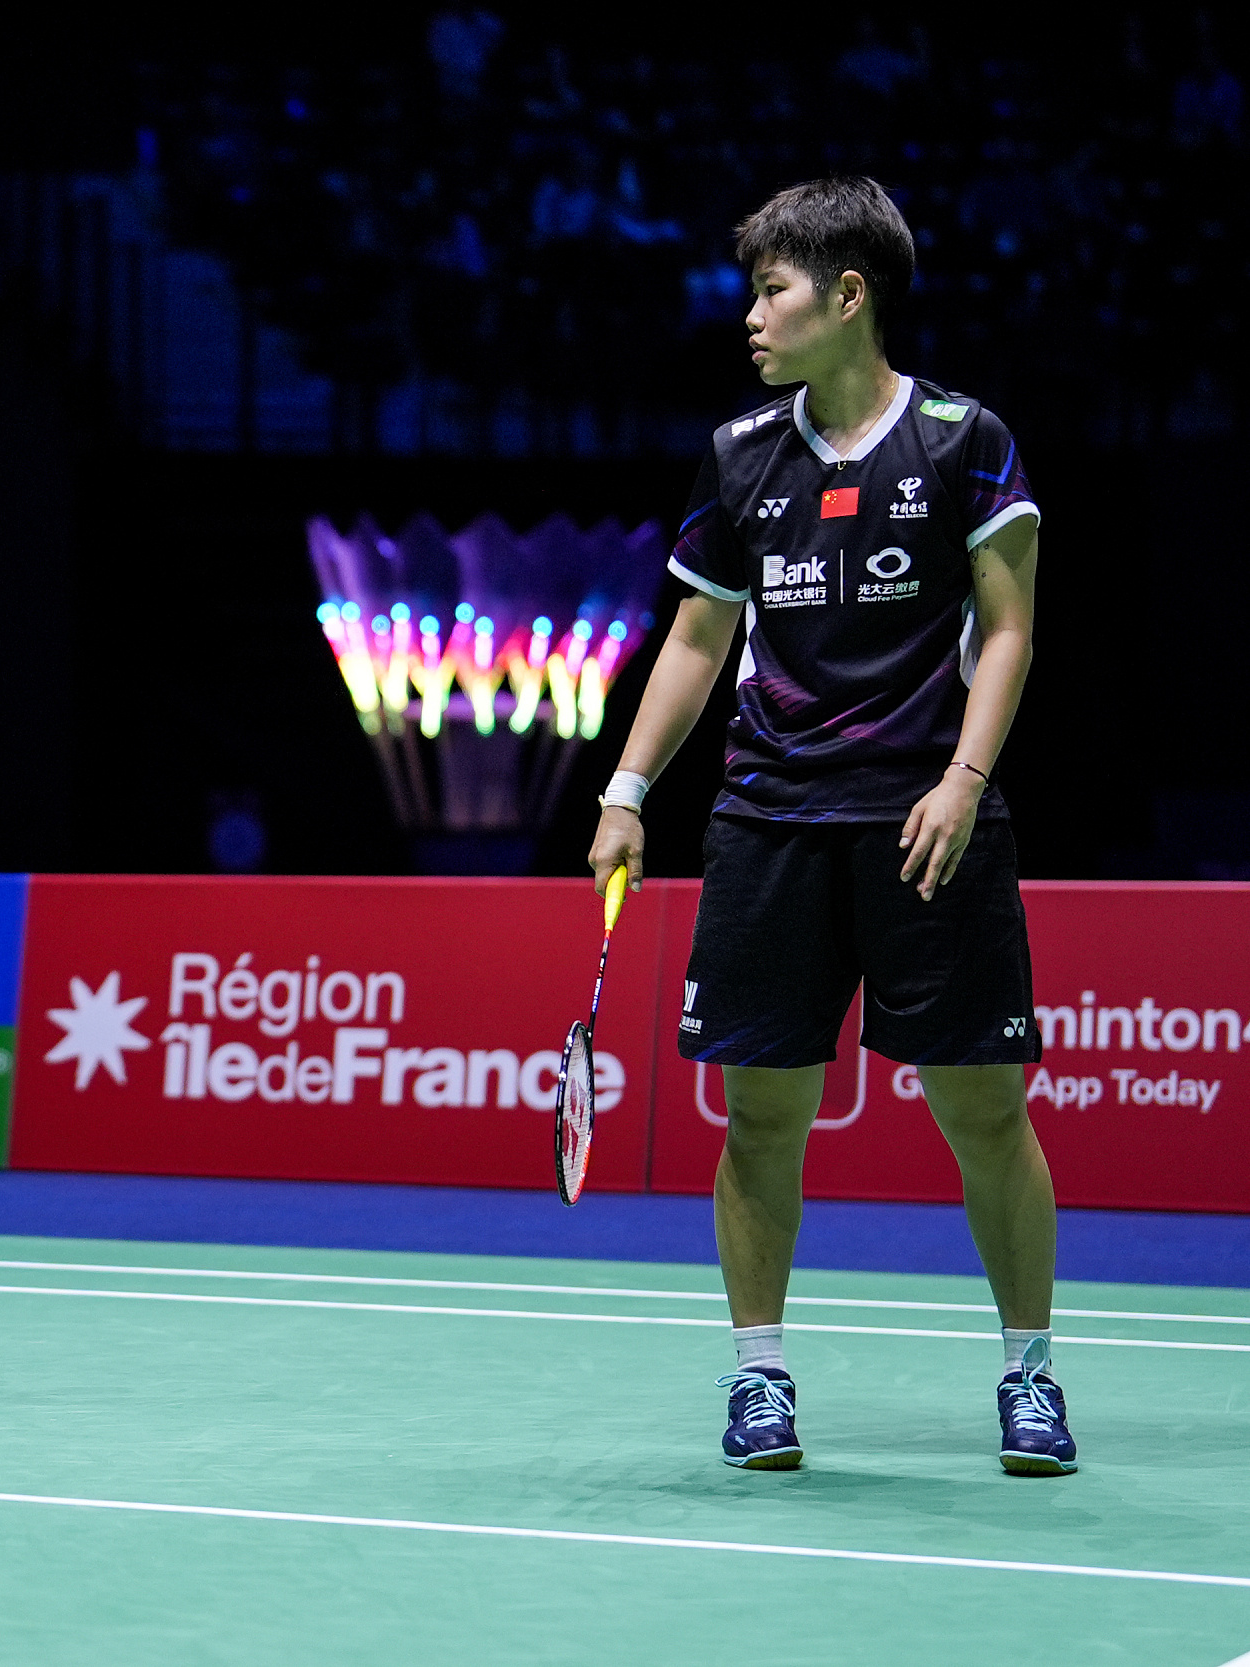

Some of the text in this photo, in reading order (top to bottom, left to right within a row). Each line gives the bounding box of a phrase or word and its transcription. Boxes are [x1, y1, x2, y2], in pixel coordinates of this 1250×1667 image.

[889, 501, 928, 515] 中国电信
[762, 555, 827, 587] Bank
[762, 586, 827, 603] 中国光大银行
[168, 952, 405, 1037] Région
[1034, 989, 1250, 1053] minton
[1027, 1066, 1104, 1111] App
[1109, 1068, 1222, 1115] Today
